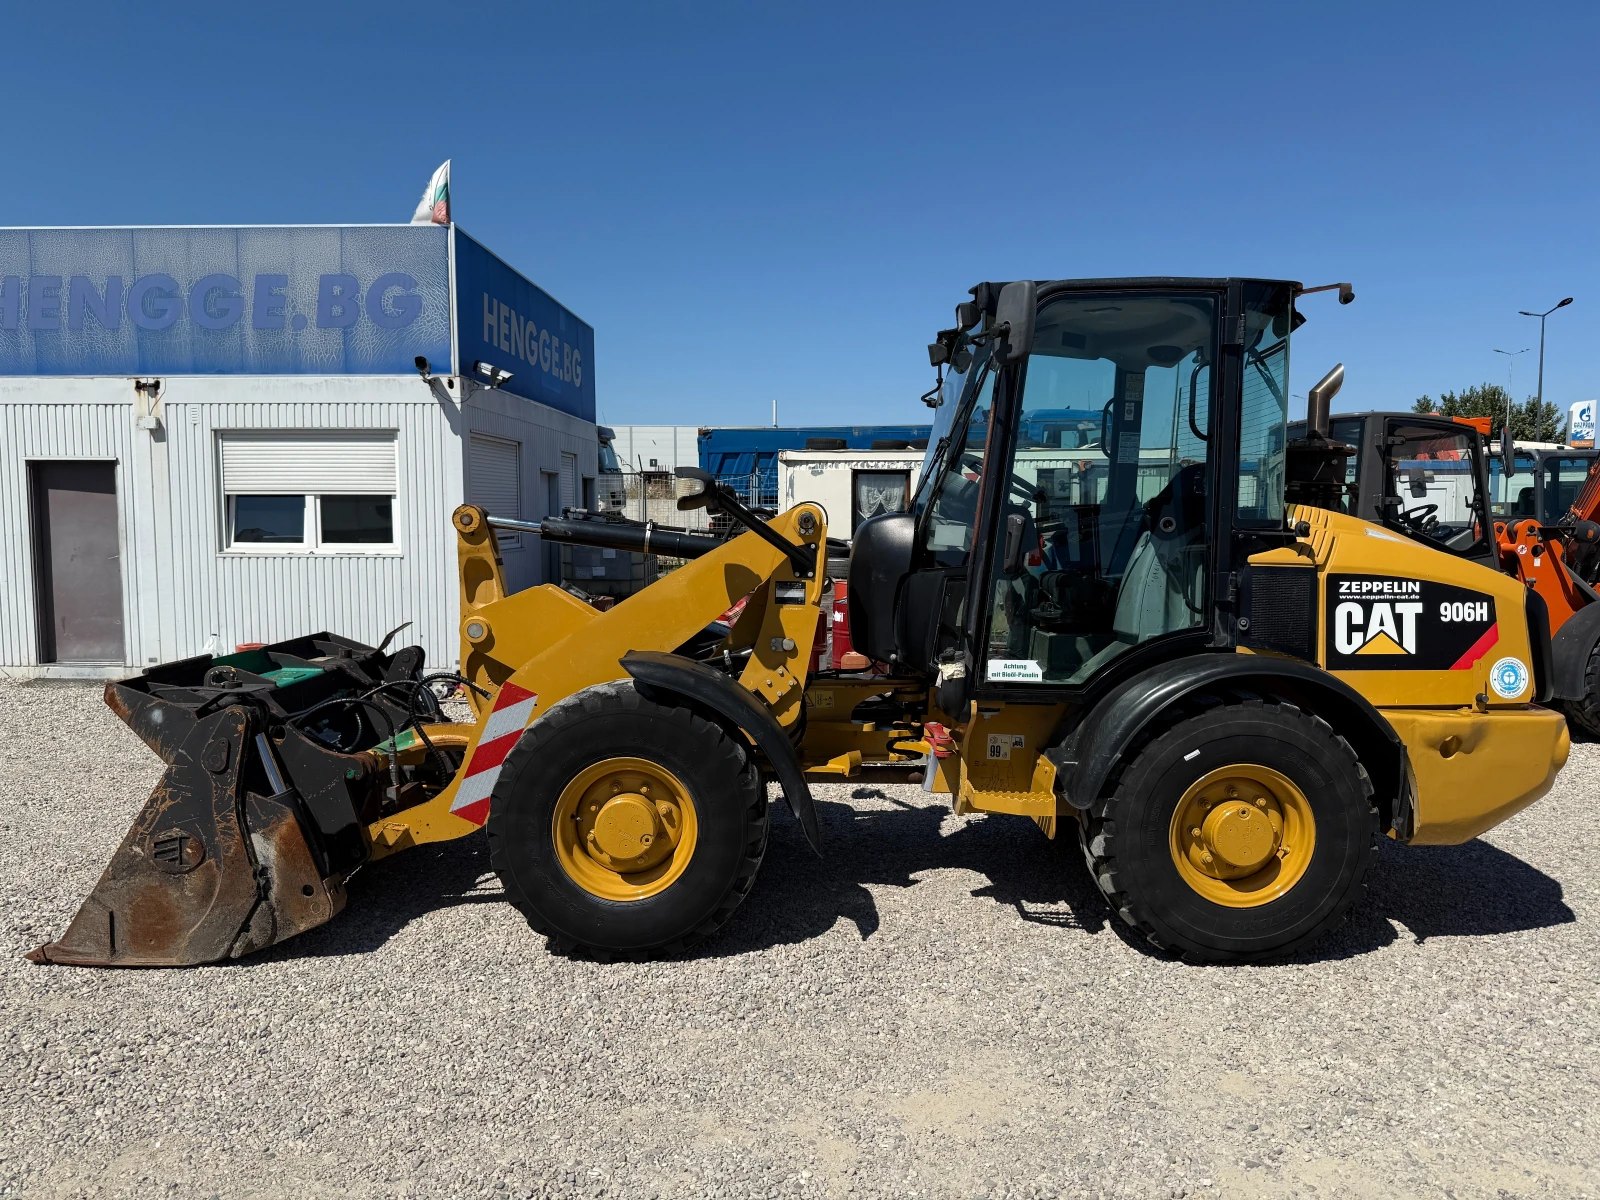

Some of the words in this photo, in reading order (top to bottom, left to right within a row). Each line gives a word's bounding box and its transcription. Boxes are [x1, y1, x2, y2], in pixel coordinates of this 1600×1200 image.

[483, 291, 582, 388] HENGGE.BG
[1338, 581, 1420, 593] ZEPPELIN
[1439, 601, 1488, 622] 906H
[1335, 602, 1423, 655] CAT
[989, 745, 1001, 757] 99
